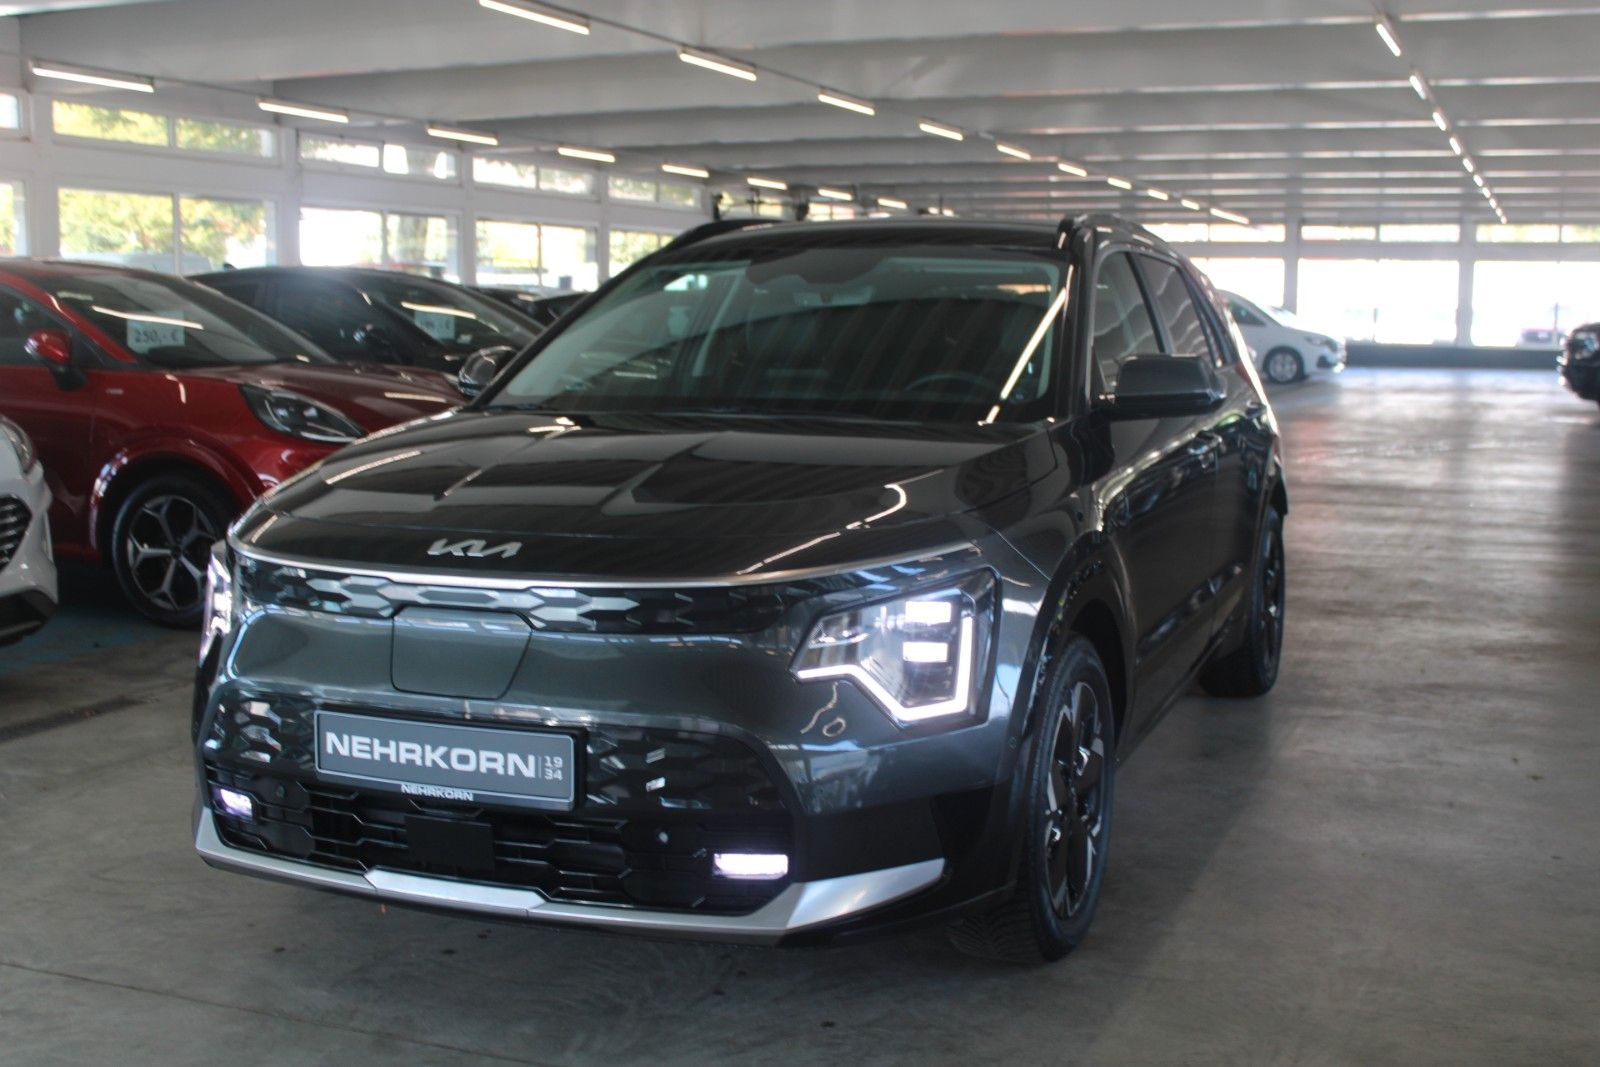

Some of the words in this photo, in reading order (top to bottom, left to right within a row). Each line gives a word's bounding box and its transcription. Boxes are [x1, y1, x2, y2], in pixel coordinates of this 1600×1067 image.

[325, 731, 536, 778] NEHRKORN
[543, 755, 563, 769] 19
[543, 769, 563, 782] 34
[401, 784, 474, 801] NEHRKORN
